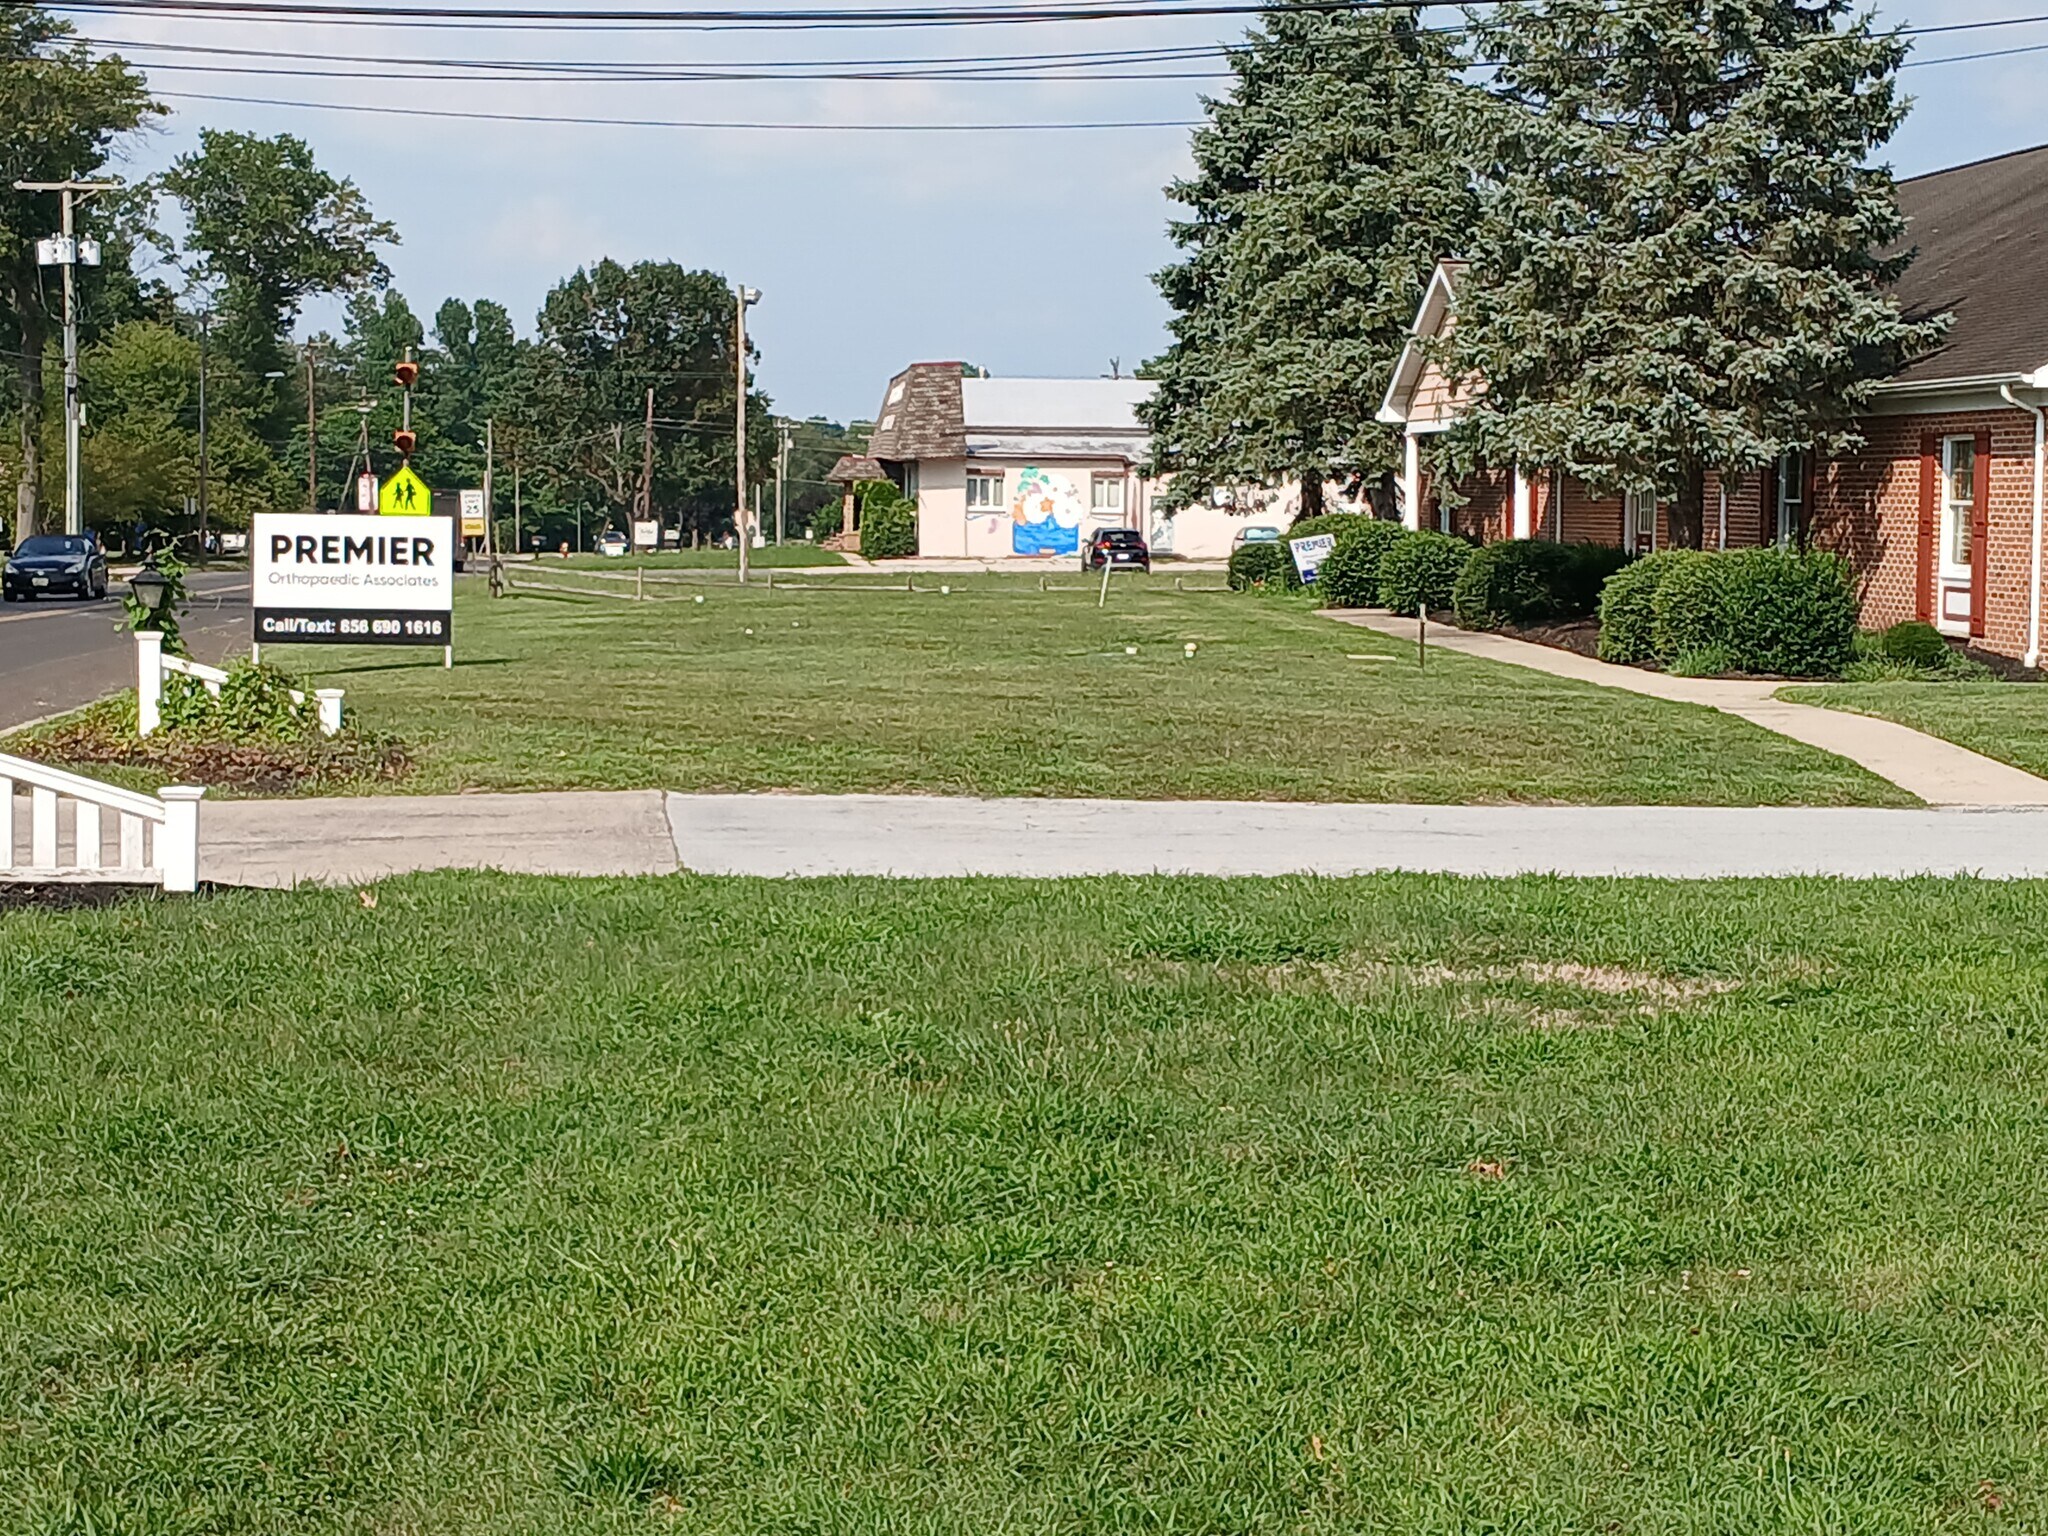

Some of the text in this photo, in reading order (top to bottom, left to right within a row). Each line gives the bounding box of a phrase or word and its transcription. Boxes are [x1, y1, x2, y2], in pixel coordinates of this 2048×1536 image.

[271, 534, 435, 566] PREMIER
[1293, 537, 1332, 552] PREMIER
[268, 571, 439, 588] Orthopaedic Associates
[262, 617, 336, 634] Call/Text:
[405, 620, 442, 635] 1616
